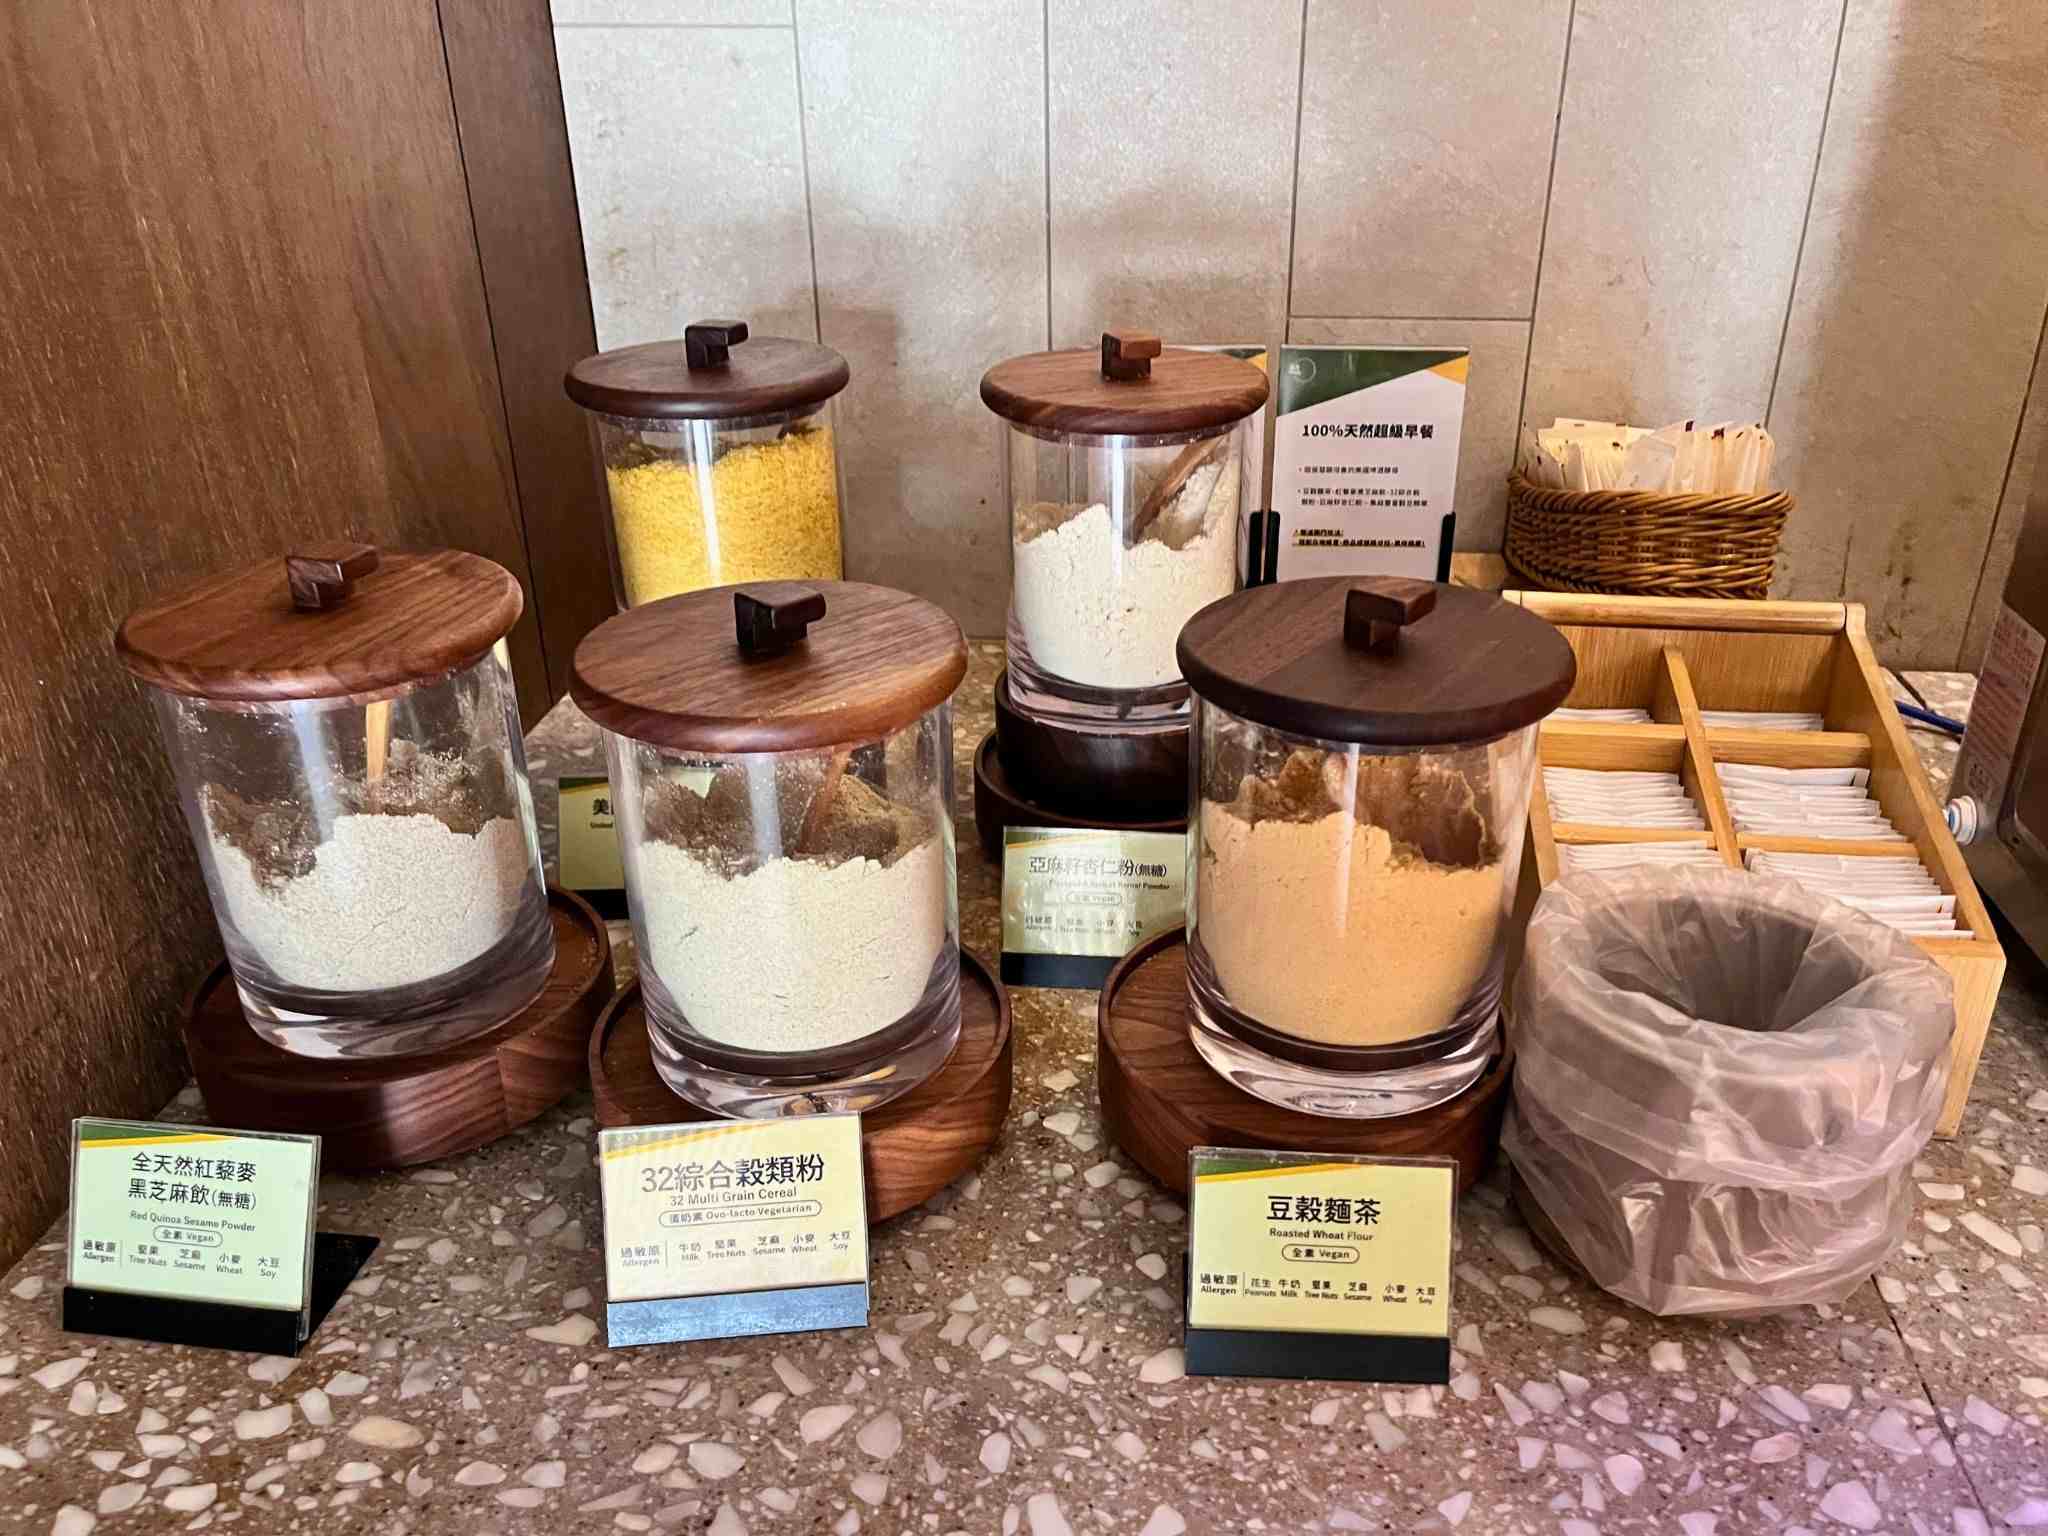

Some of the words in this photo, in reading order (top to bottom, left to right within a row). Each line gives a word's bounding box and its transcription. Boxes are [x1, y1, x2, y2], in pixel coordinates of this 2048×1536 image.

[1302, 423, 1434, 440] 100%天然超級早餐
[131, 1151, 257, 1183] 全天然紅藜麥
[640, 1153, 825, 1194] 32綜合穀類粉
[128, 1177, 257, 1211] 黑芝麻飲(無糖)
[670, 1195, 685, 1207] 32
[688, 1193, 719, 1205] Multi
[722, 1191, 755, 1203] Grain
[758, 1186, 797, 1200] Cereal
[757, 1203, 813, 1218] Vegetarian
[1266, 1195, 1382, 1226] 豆穀麵茶
[130, 1209, 148, 1221] Red
[149, 1212, 182, 1225] Quinoa
[184, 1215, 219, 1229] Sesame
[221, 1219, 256, 1232] Powder
[1269, 1227, 1311, 1239] Roasted
[1312, 1229, 1345, 1241] Wheat
[1347, 1231, 1375, 1242] Flour
[257, 1256, 280, 1268] 大豆
[1319, 1248, 1351, 1260] Vegan
[260, 1268, 277, 1280] Soy
[1200, 1284, 1237, 1296] Allergen
